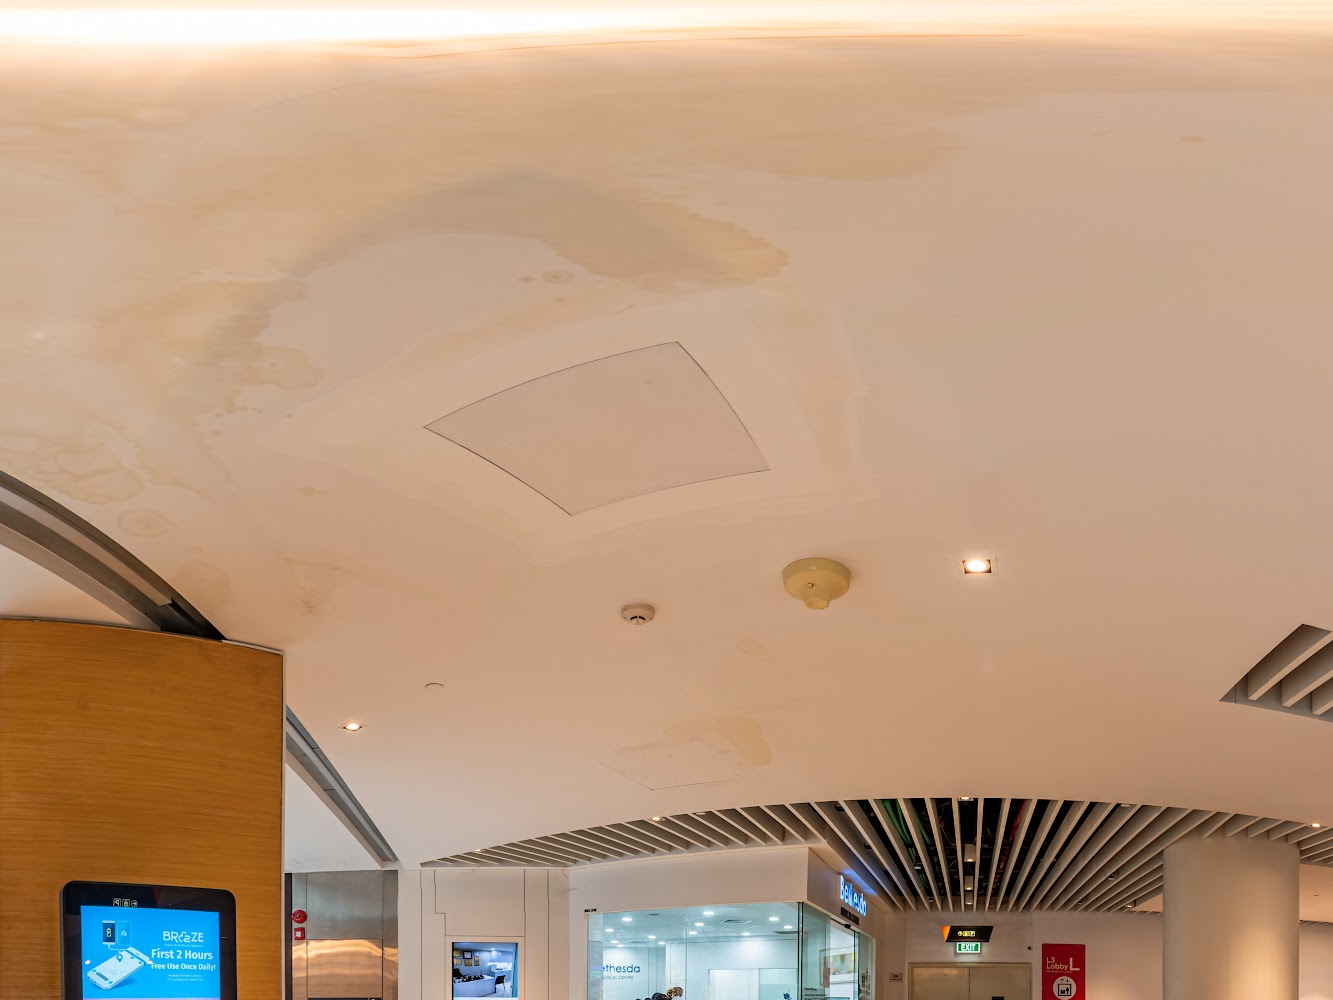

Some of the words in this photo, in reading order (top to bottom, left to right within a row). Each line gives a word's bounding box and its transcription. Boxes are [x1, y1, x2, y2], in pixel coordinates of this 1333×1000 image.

[151, 949, 173, 960] First
[176, 950, 182, 959] 2
[185, 950, 213, 960] Hours
[198, 963, 216, 972] Daily!
[1070, 957, 1080, 971] L
